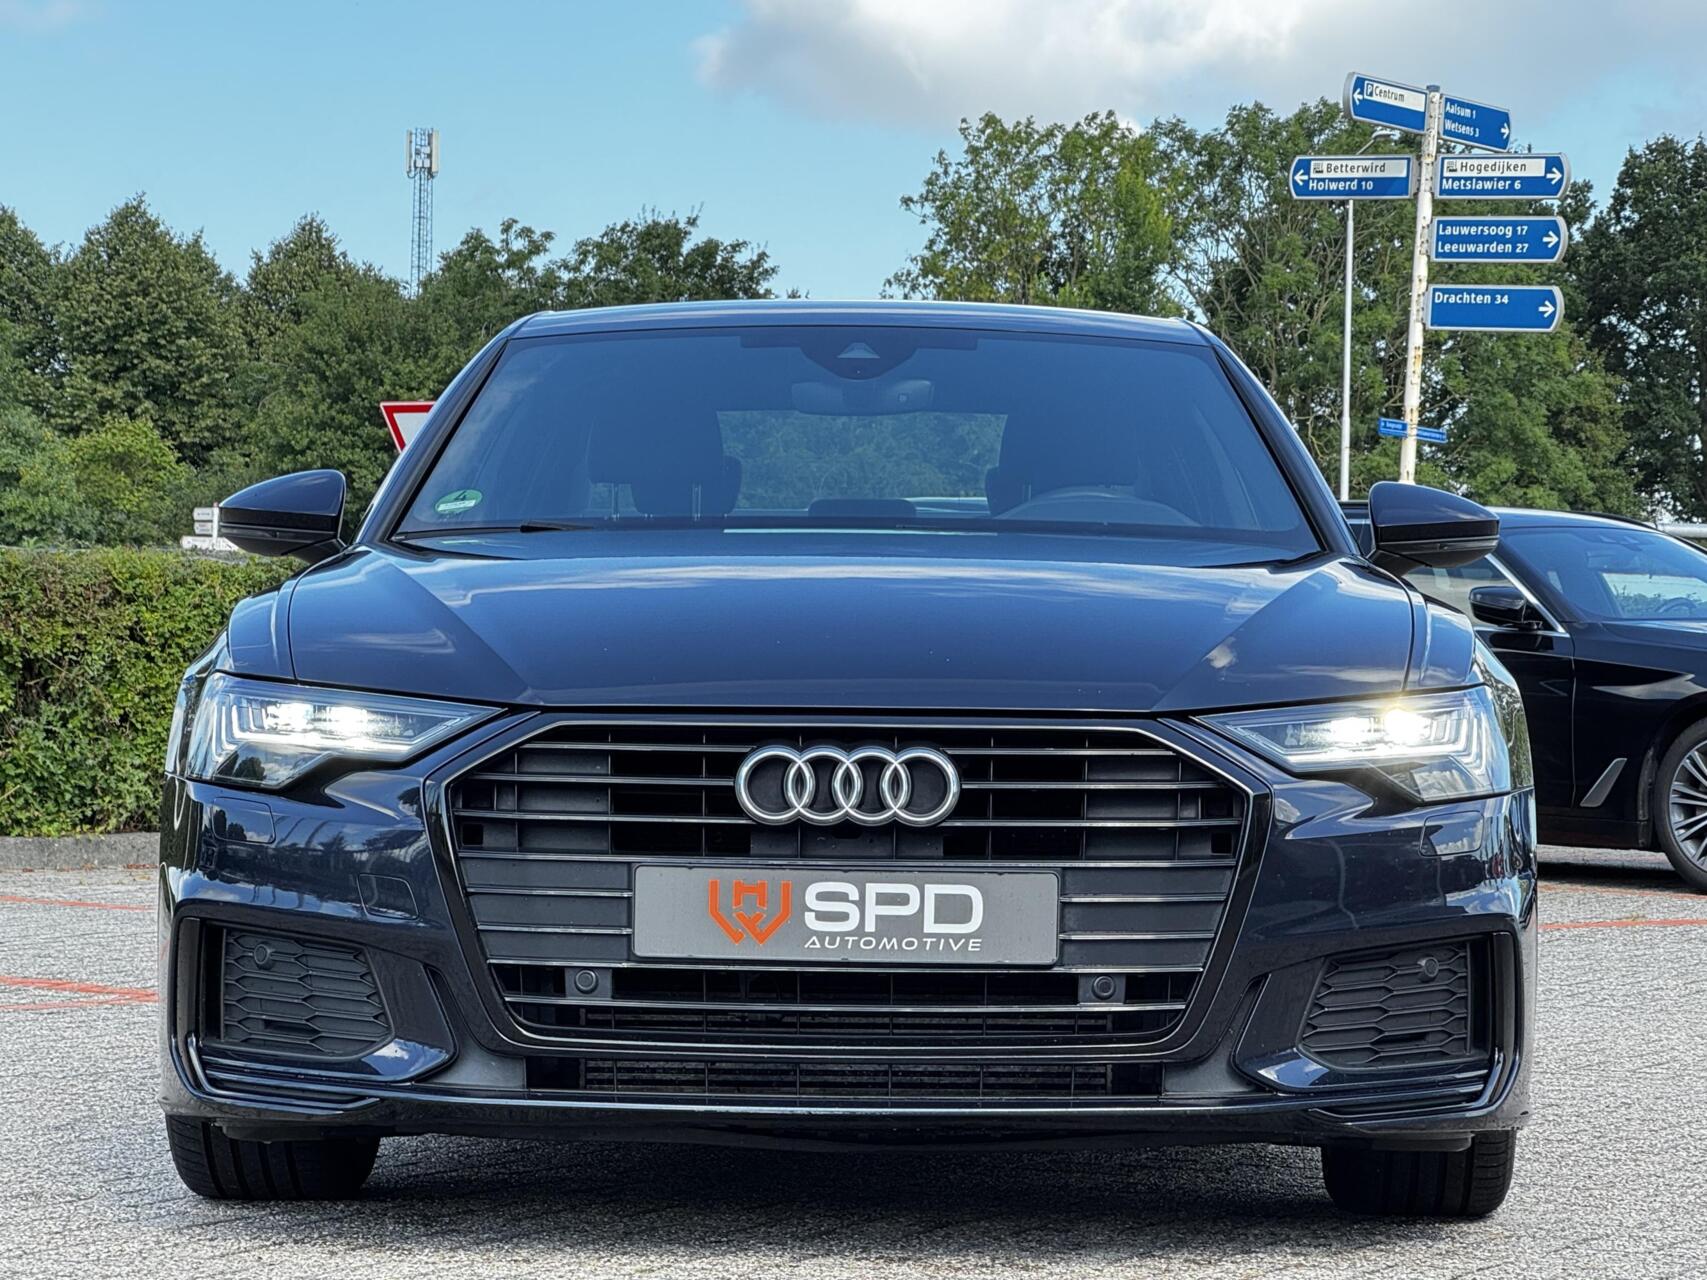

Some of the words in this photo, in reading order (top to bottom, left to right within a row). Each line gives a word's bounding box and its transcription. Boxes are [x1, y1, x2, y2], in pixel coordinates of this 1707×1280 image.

[1374, 85, 1405, 102] Centrum
[1446, 102, 1471, 117] Aalsum
[1472, 110, 1476, 119] 1
[1445, 119, 1474, 136] Wetsens
[1475, 128, 1479, 138] 3
[1326, 162, 1386, 174] Betterwird
[1460, 161, 1527, 174] Hogedijken
[1309, 179, 1357, 190] Holwerd
[1361, 181, 1373, 190] 10
[1441, 178, 1511, 190] Metslawier
[1514, 180, 1521, 190] 6
[1439, 223, 1513, 238] Lauwersoog
[1516, 225, 1529, 235] 17
[1438, 241, 1512, 253] Leeuwarden
[1516, 243, 1529, 253] 27
[1434, 291, 1491, 304] Drachten
[1494, 294, 1509, 305] 34
[804, 881, 984, 934] SPD
[804, 935, 982, 951] AUTOMOTIVE
